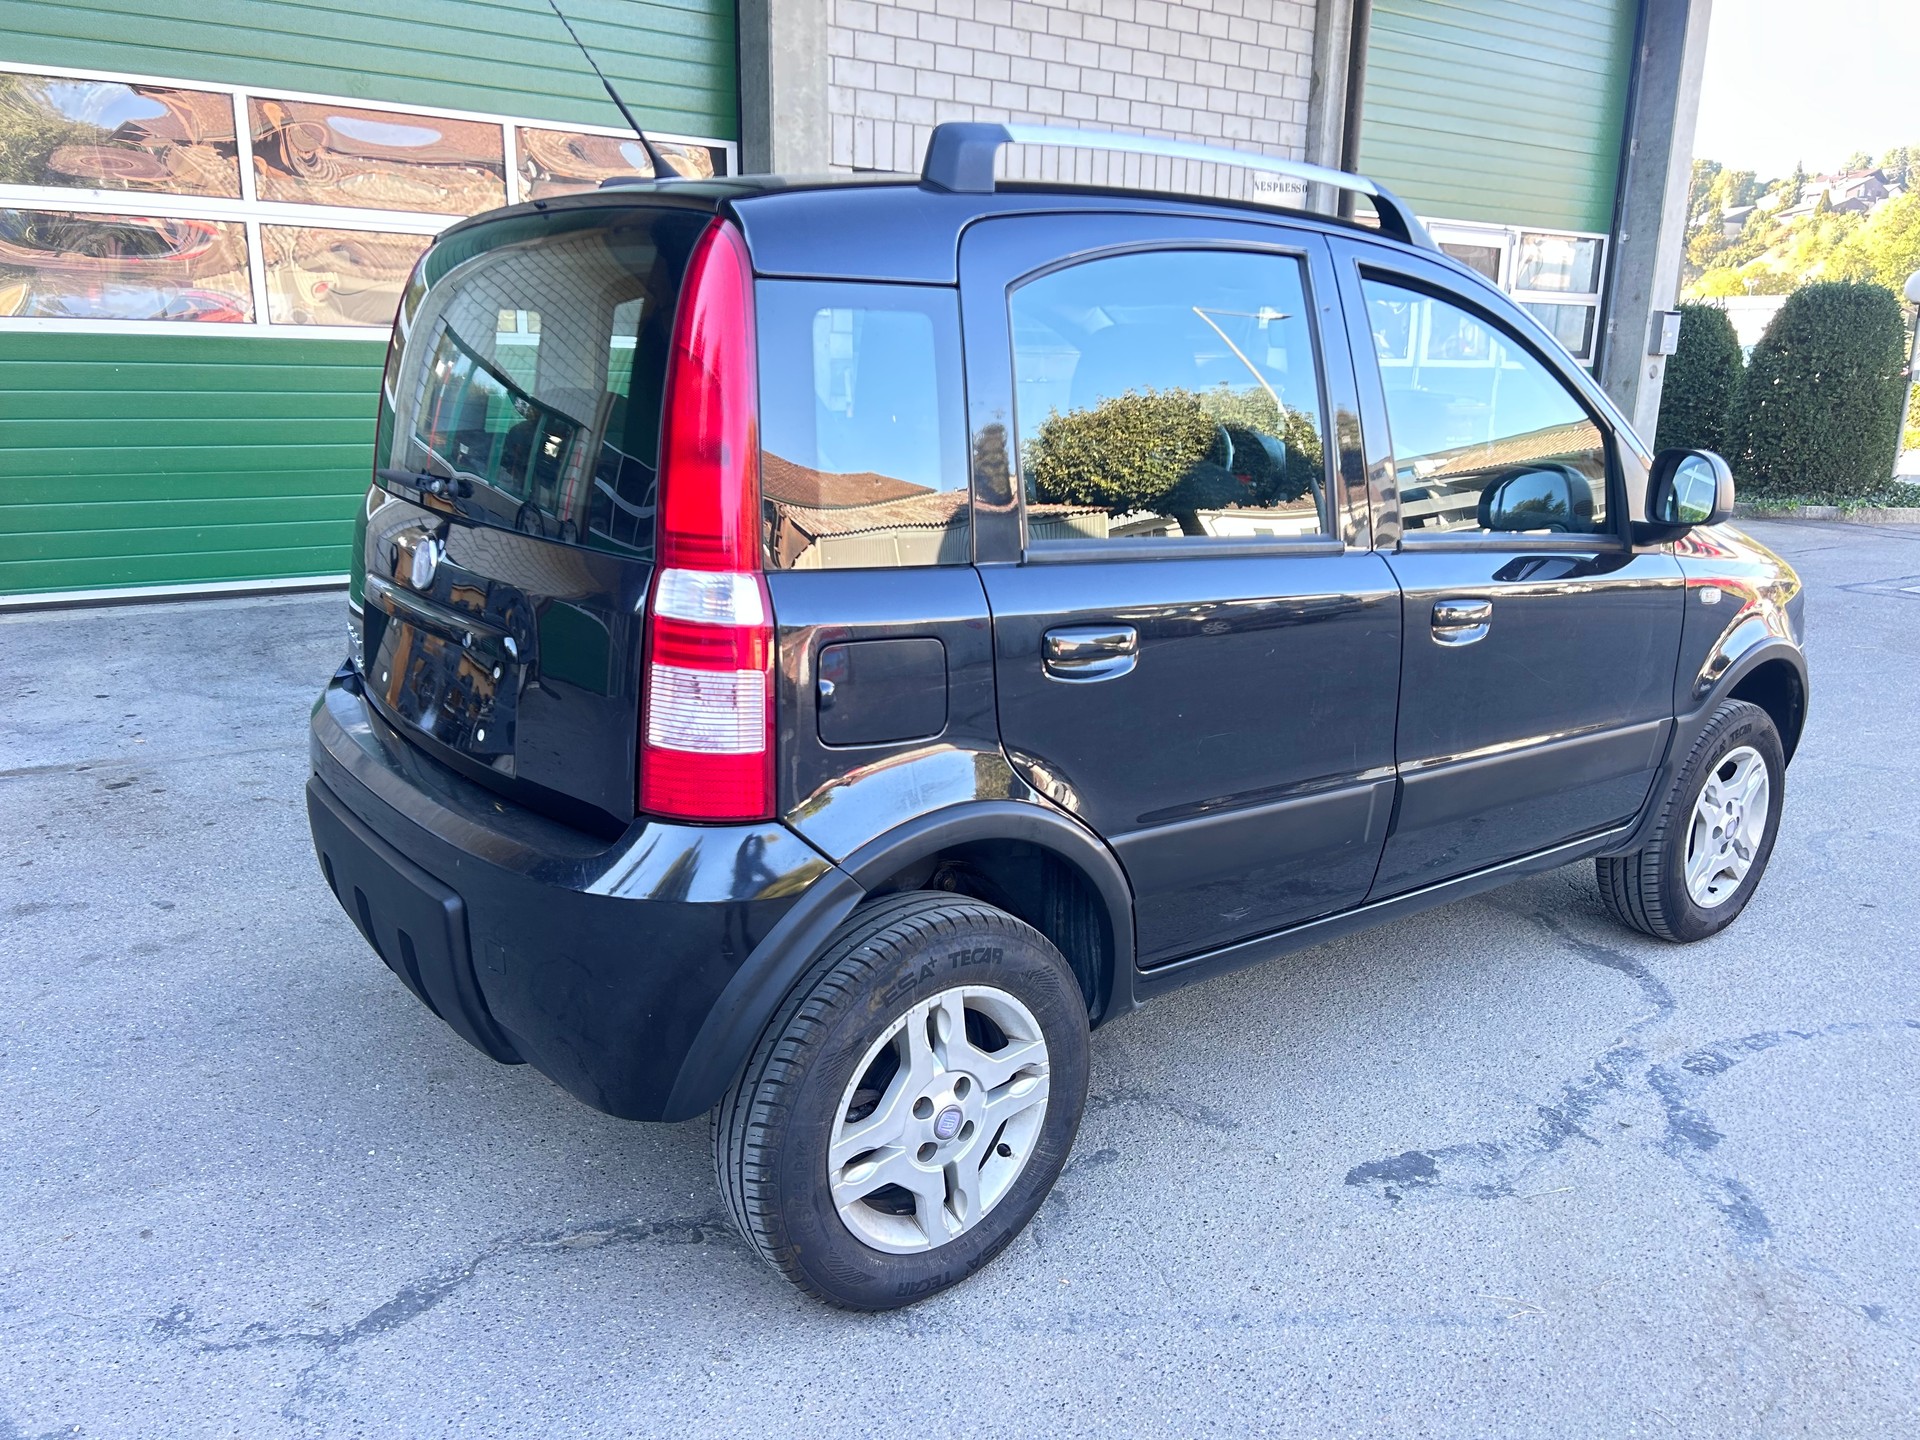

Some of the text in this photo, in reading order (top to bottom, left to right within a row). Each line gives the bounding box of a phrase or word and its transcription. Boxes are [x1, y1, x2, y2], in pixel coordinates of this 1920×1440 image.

[1254, 181, 1308, 193] NESPRESSO
[948, 947, 1004, 969] TECAR
[941, 1112, 957, 1135] FIAT
[895, 1271, 954, 1298] TECAR
